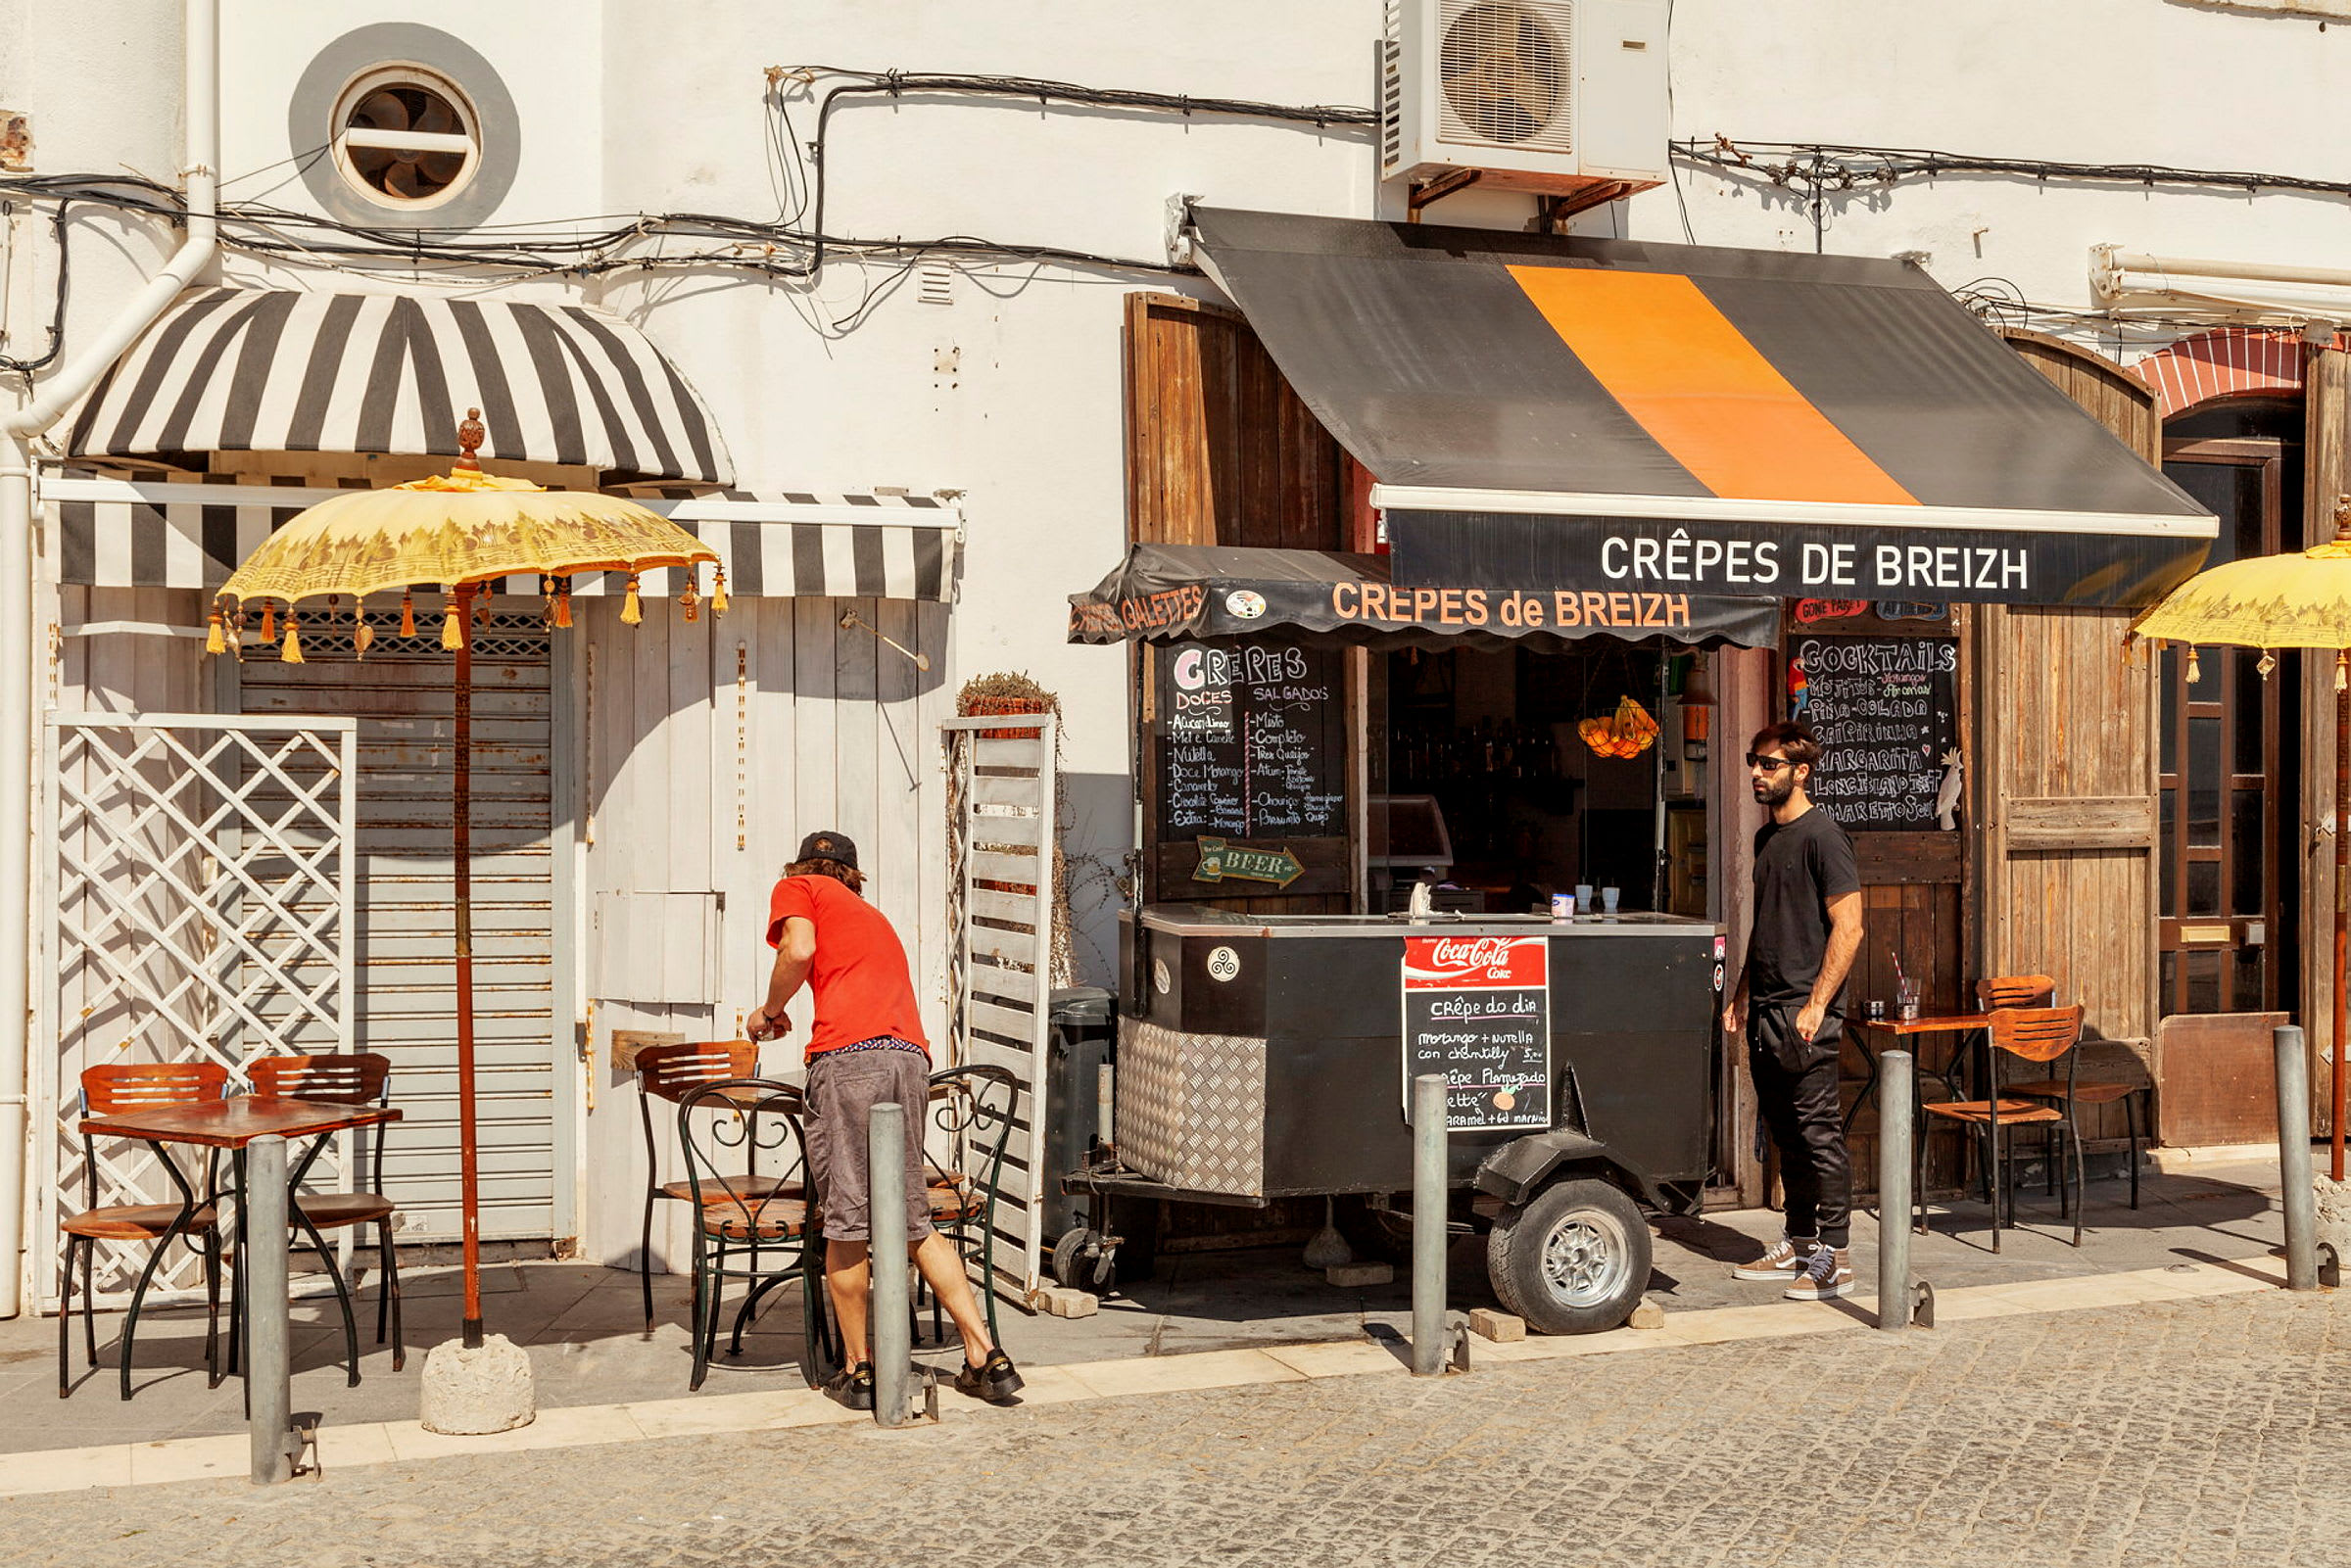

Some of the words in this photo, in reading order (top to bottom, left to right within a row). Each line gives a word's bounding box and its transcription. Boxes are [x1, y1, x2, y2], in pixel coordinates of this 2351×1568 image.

[1602, 528, 1779, 584] CRÊPES
[1802, 543, 1856, 585] DE
[1876, 545, 2028, 589] BREIZH
[1122, 585, 1203, 631] GALETTES
[1500, 591, 1543, 627] de
[1555, 591, 1690, 627] BREIZH
[1176, 689, 1232, 710] DOCES
[1253, 686, 1330, 701] SALGADOS
[1255, 728, 1307, 748] Completo
[1174, 745, 1217, 763] Nutella
[1224, 851, 1283, 875] BEER
[1432, 937, 1511, 968] Coca-Cola
[1486, 966, 1512, 979] Coke
[1485, 995, 1507, 1014] do
